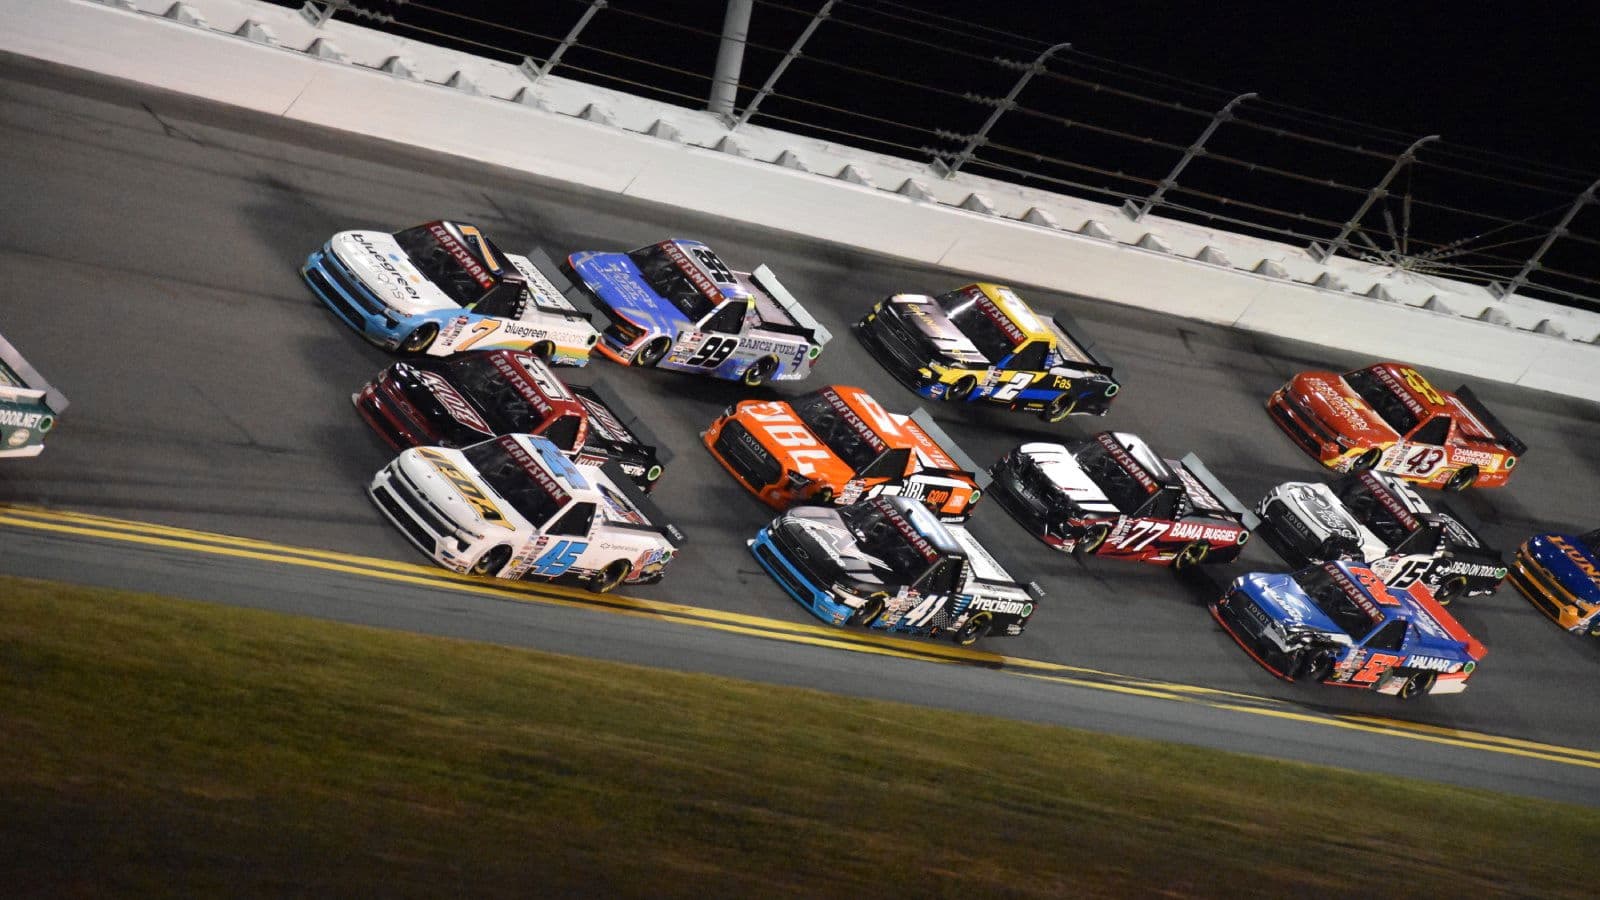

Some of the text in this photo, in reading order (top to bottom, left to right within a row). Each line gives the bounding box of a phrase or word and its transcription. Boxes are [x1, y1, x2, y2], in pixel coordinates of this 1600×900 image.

[429, 224, 494, 283] CRAFTSMAN
[662, 243, 718, 297] CRAFTSMAN
[455, 318, 502, 351] 7
[505, 321, 548, 338] bluegreen
[738, 338, 772, 351] RANCH
[685, 336, 739, 368] 99
[490, 354, 551, 413] CRAFTSMAN
[991, 373, 1037, 402] 2
[1053, 375, 1071, 389] Fas
[1372, 366, 1424, 414] CRAFTSMAN
[823, 390, 880, 446] CRAFTSMAN
[742, 432, 768, 459] TOYOTA
[1098, 434, 1153, 486] CRAFTSMAN
[1451, 455, 1491, 466] CONTAINER
[1454, 447, 1494, 459] CHAMPION
[502, 438, 566, 500] CRAFTSMAN
[1407, 448, 1444, 475] 43
[1361, 474, 1414, 526] CRAFTSMAN
[875, 499, 936, 557] CRAFTSMAN
[1117, 520, 1170, 551] 77
[1169, 523, 1238, 541] BAMA BUGGIES
[1285, 511, 1308, 536] TOYOTA
[533, 540, 590, 574] 45
[1450, 561, 1469, 574] DEAD
[1468, 565, 1480, 575] ON
[1386, 560, 1433, 590] 15
[968, 595, 1024, 614] Precision
[1325, 564, 1380, 617] CRAFTSMAN
[905, 595, 949, 627] 41
[1248, 603, 1270, 625] TOYOT
[1408, 655, 1450, 672] HALMAR
